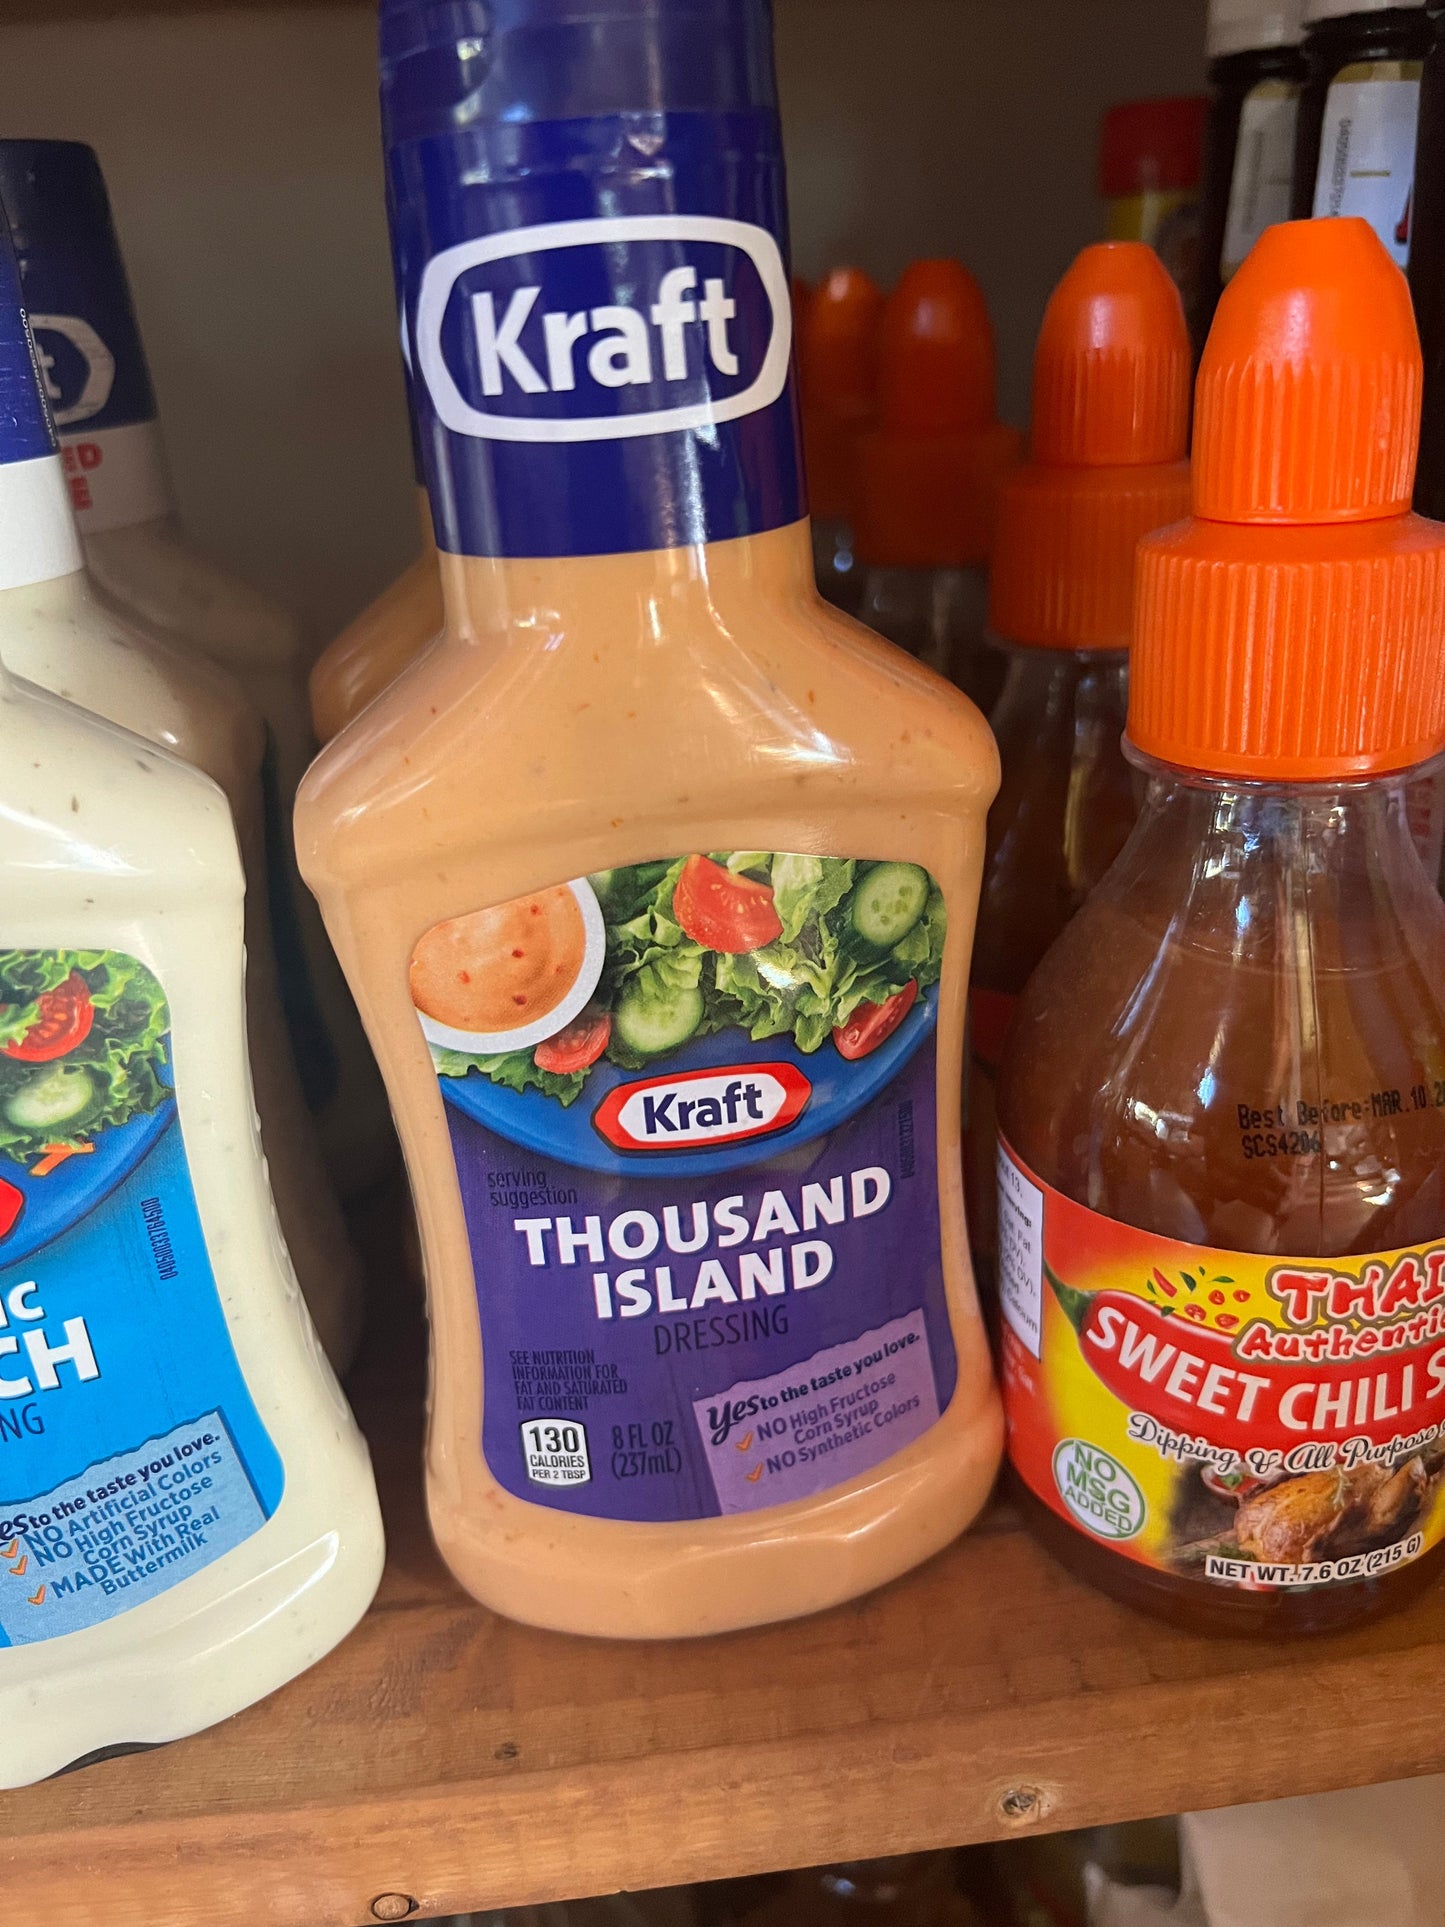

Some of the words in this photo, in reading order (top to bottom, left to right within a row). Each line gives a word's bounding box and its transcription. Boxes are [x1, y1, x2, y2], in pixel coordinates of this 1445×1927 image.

[472, 266, 739, 396] Kraft
[643, 1082, 764, 1135] Kraft
[1237, 1103, 1285, 1130] Best
[487, 1168, 547, 1188] serving
[490, 1187, 577, 1209] suggestion
[514, 1166, 895, 1266] THOUSAND
[593, 1239, 835, 1320] ISLAND
[654, 1305, 789, 1356] DRESSING
[509, 1350, 533, 1365] SEE
[533, 1349, 595, 1364] NUTRITION
[512, 1365, 592, 1381] INFORMATION
[596, 1364, 619, 1379] FOR
[760, 1395, 778, 1410] to
[780, 1383, 810, 1403] the
[810, 1366, 852, 1392] taste
[853, 1351, 884, 1375] you
[884, 1331, 920, 1358] love.
[1086, 1306, 1271, 1423] SWEET
[1278, 1364, 1413, 1431] CHILI
[515, 1381, 532, 1396] FAT
[536, 1380, 561, 1395] AND
[565, 1379, 628, 1396] SATURATED
[517, 1396, 536, 1411] FAT
[539, 1396, 589, 1411] CONTENT
[756, 1417, 787, 1442] NO
[789, 1403, 829, 1431] High
[829, 1371, 897, 1414] Fructose
[529, 1426, 580, 1453] 130
[612, 1425, 624, 1450] 8
[628, 1423, 648, 1449] FL
[652, 1420, 675, 1446] OZ
[765, 1450, 796, 1475] NO
[799, 1422, 873, 1463] Synthetic
[873, 1394, 921, 1428] Colors
[793, 1421, 833, 1445] Corn
[835, 1399, 880, 1430] Syrup
[1129, 1413, 1236, 1474] Dipping
[1288, 1444, 1336, 1469] All
[1343, 1426, 1436, 1467] Purpose
[28, 1513, 51, 1530] to
[51, 1495, 87, 1521] the
[86, 1473, 137, 1504] taste
[137, 1455, 175, 1483] you
[173, 1432, 221, 1462] love.
[530, 1455, 585, 1468] CALORIES
[532, 1469, 551, 1479] PER
[553, 1470, 560, 1479] 2
[562, 1469, 586, 1480] TBSP
[611, 1449, 682, 1480] (237mL)
[1074, 1440, 1116, 1483] NO
[22, 1524, 64, 1551] NO
[68, 1481, 158, 1538] Artificial
[157, 1450, 223, 1491] Colors
[1064, 1488, 1133, 1535] ADDED
[1066, 1462, 1130, 1515] MSG
[33, 1540, 73, 1568] NO
[74, 1518, 126, 1552] High
[124, 1474, 214, 1529] Fructose
[83, 1533, 134, 1566] Corn
[133, 1504, 194, 1541] Syrup
[50, 1556, 126, 1599] MADE
[123, 1529, 176, 1566] With
[174, 1505, 221, 1538] Real
[100, 1531, 209, 1596] Buttermilk
[1210, 1560, 1251, 1579] NET
[1256, 1565, 1295, 1582] WT.
[1303, 1564, 1331, 1581] 7.6
[1337, 1557, 1360, 1577] OZ
[1366, 1545, 1402, 1573] (215
[1406, 1535, 1422, 1556] G)
